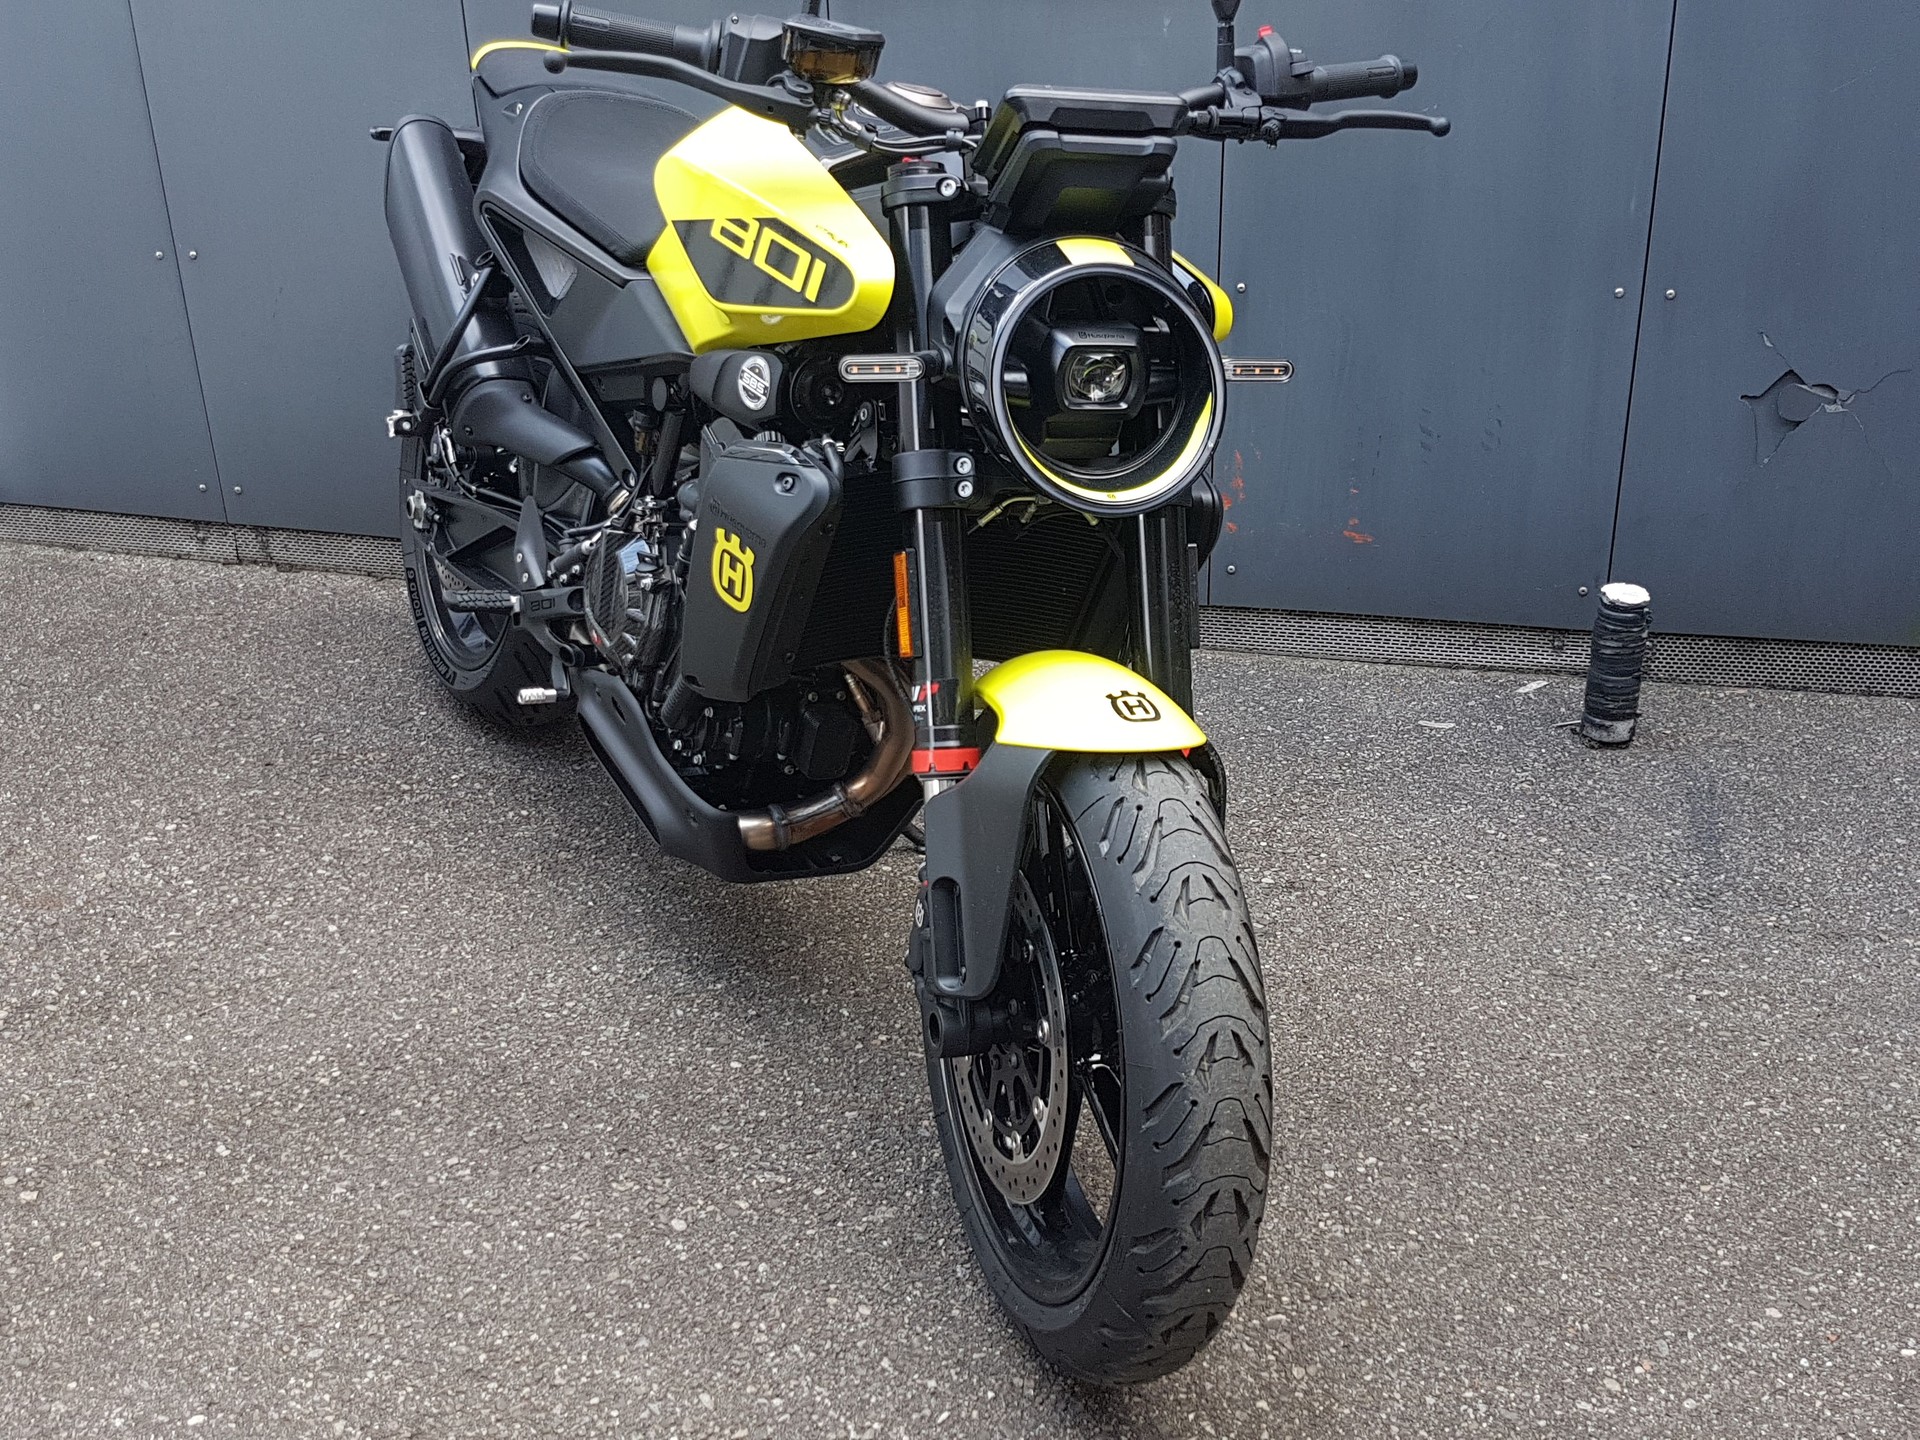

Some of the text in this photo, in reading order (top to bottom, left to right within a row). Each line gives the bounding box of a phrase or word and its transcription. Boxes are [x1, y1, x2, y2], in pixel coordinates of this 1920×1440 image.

[711, 217, 827, 303] 801
[742, 372, 766, 395] SBS
[409, 583, 425, 618] ROAD
[530, 598, 556, 612] 801
[420, 625, 449, 678] MICHELIN
